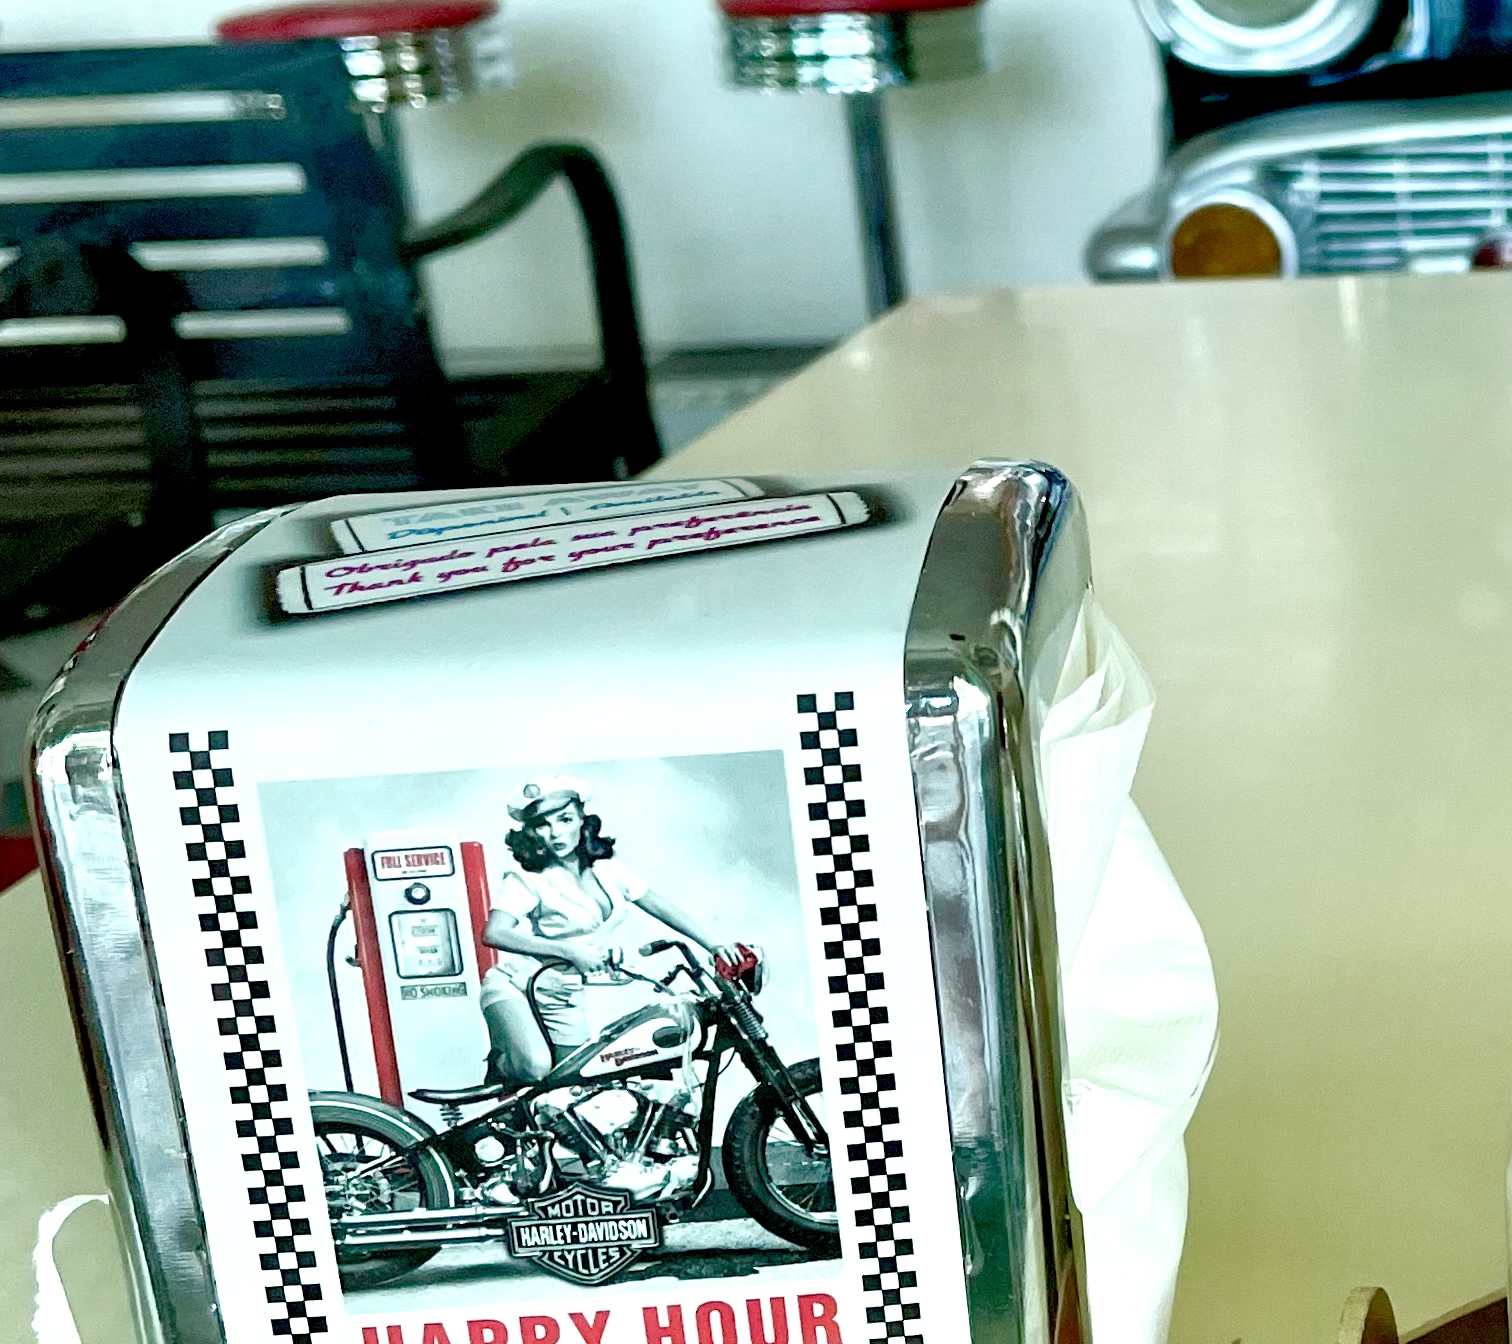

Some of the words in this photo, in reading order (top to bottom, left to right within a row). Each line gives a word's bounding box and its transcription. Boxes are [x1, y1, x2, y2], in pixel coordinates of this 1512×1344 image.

[325, 572, 422, 596] Thank
[437, 565, 488, 582] you
[502, 553, 555, 573] for
[569, 543, 634, 563] your
[647, 516, 820, 549] preference
[325, 550, 475, 577] Obrigado
[486, 537, 556, 557] pela
[405, 852, 445, 867] SERVICE
[547, 1194, 614, 1218] MOTOR
[520, 1219, 648, 1247] HARLEY-DAVIDSON
[553, 1247, 620, 1274] CYCLES
